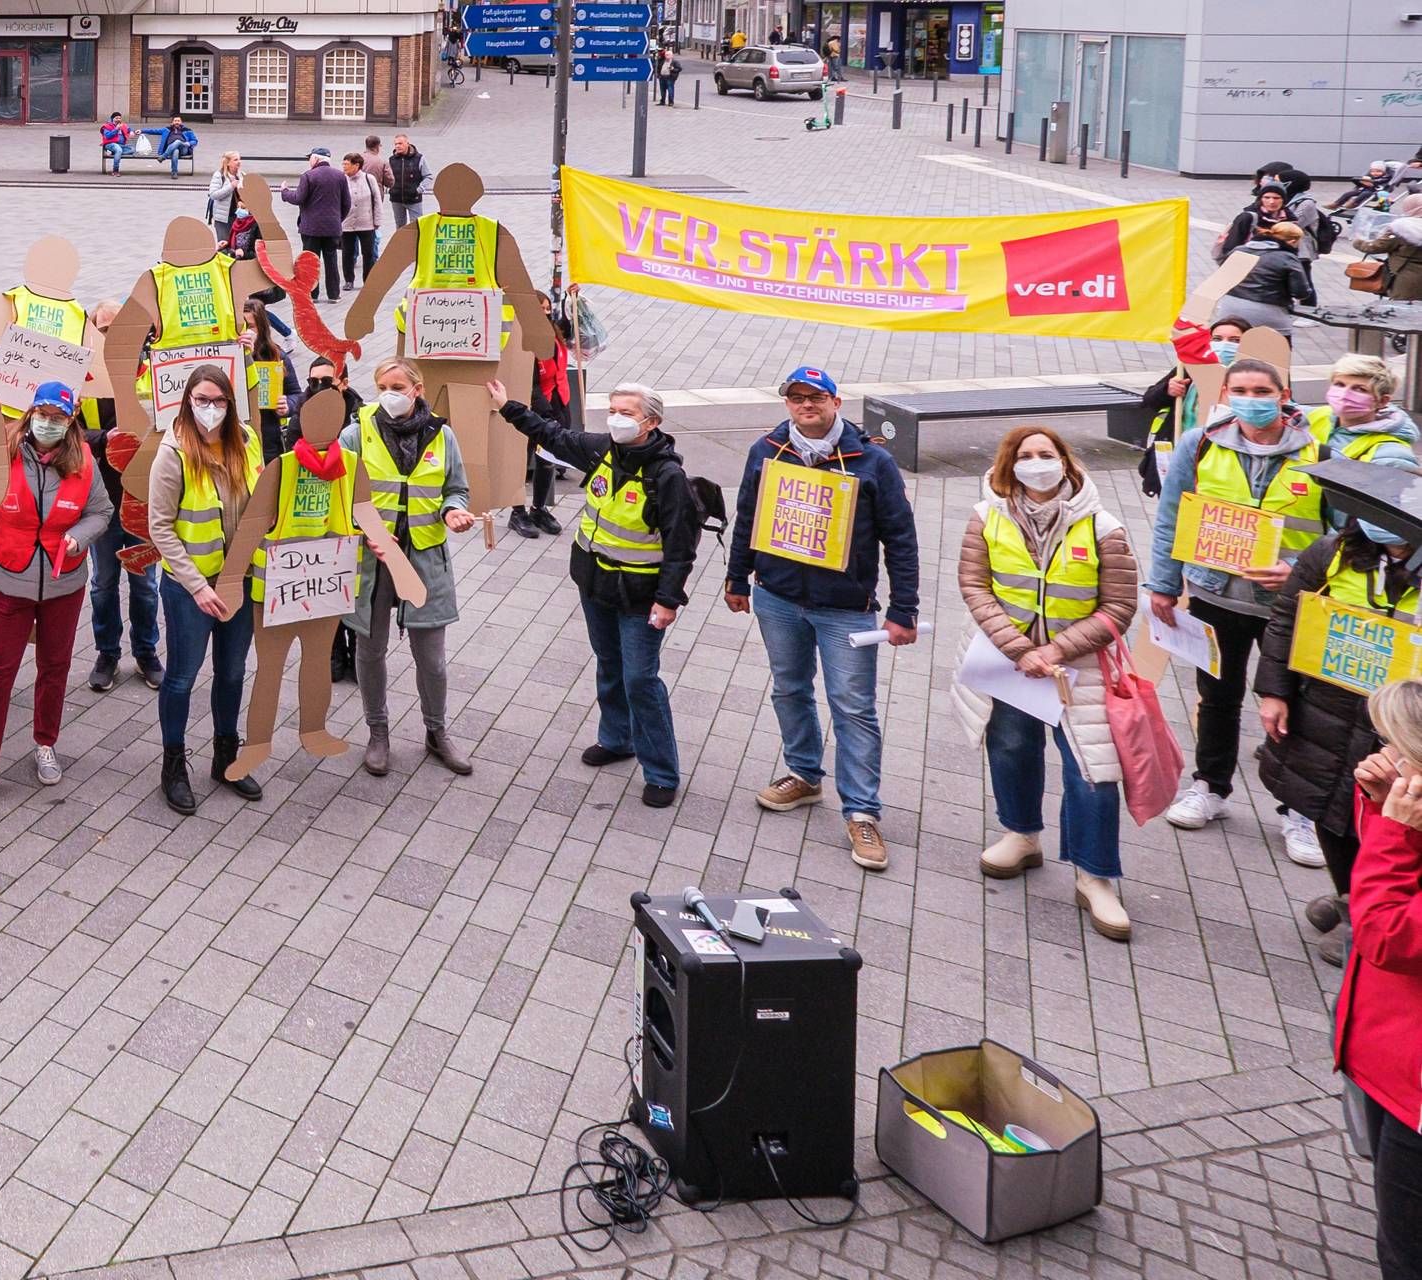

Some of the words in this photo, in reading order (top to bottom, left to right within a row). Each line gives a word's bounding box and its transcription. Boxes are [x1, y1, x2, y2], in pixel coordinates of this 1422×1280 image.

[236, 16, 298, 33] König-City
[436, 223, 476, 239] MEHR
[435, 244, 476, 254] BRAUCHT
[617, 202, 970, 294] VER.STÄRKT
[435, 254, 475, 269] MEHR
[174, 272, 212, 290] MEHR
[641, 261, 710, 283] SOZIAL-
[715, 275, 747, 289] UND
[752, 279, 934, 309] ERZIEHUNGSBERUFE
[1013, 275, 1116, 299] ver.di
[178, 294, 214, 305] BRAUCHT
[28, 303, 65, 322] MEHR
[178, 303, 217, 321] MEHR
[158, 350, 186, 362] Ohne
[294, 493, 331, 511] MEHR
[777, 476, 834, 508] MEHR
[774, 504, 833, 529] BRAUCHT
[1202, 503, 1258, 532] MEHR
[771, 518, 828, 551] MEHR
[1198, 526, 1259, 550] BRAUCHT
[1195, 537, 1252, 568] MEHR
[275, 570, 353, 606] FEHLST
[1329, 612, 1395, 648] MEHR
[1326, 637, 1393, 668] BRAUCHT
[1322, 648, 1388, 687] MEHR
